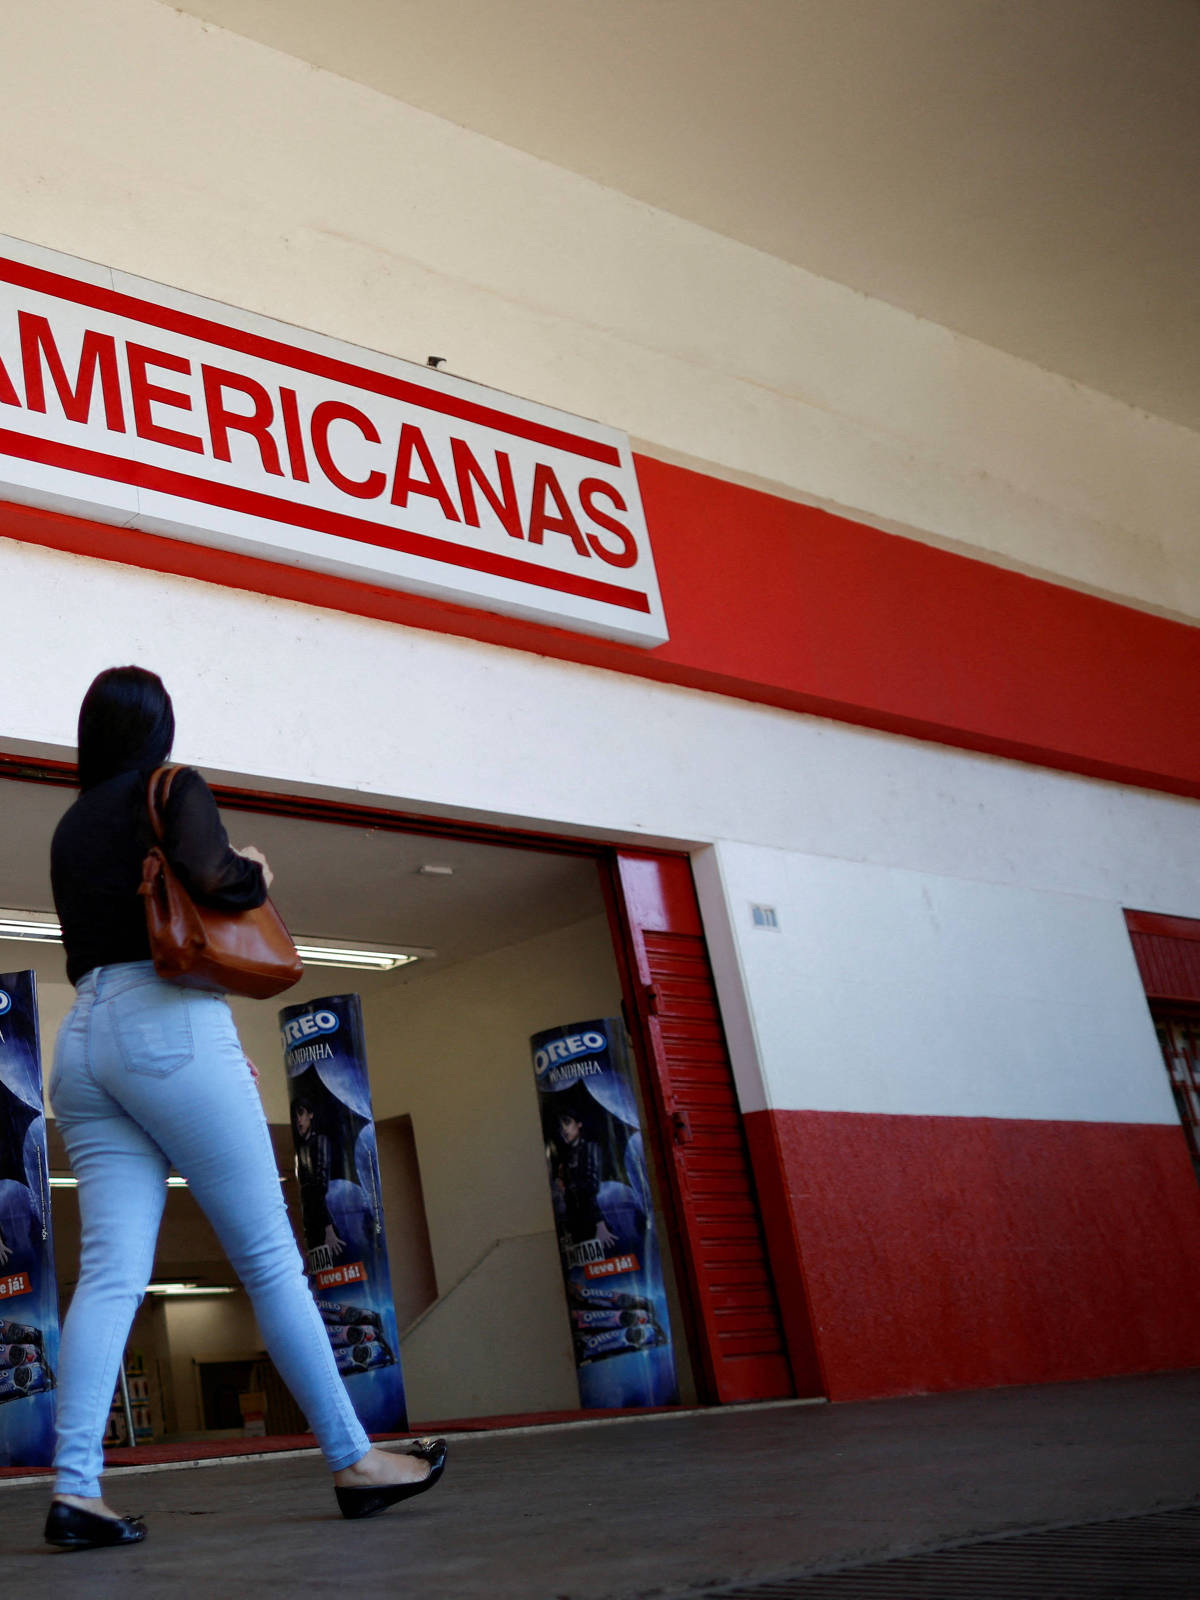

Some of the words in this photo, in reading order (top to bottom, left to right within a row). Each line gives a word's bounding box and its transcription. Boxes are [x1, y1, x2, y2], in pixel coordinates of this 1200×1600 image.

[282, 1012, 337, 1050] REO
[535, 1032, 604, 1075] OREO
[8, 1277, 24, 1295] já!
